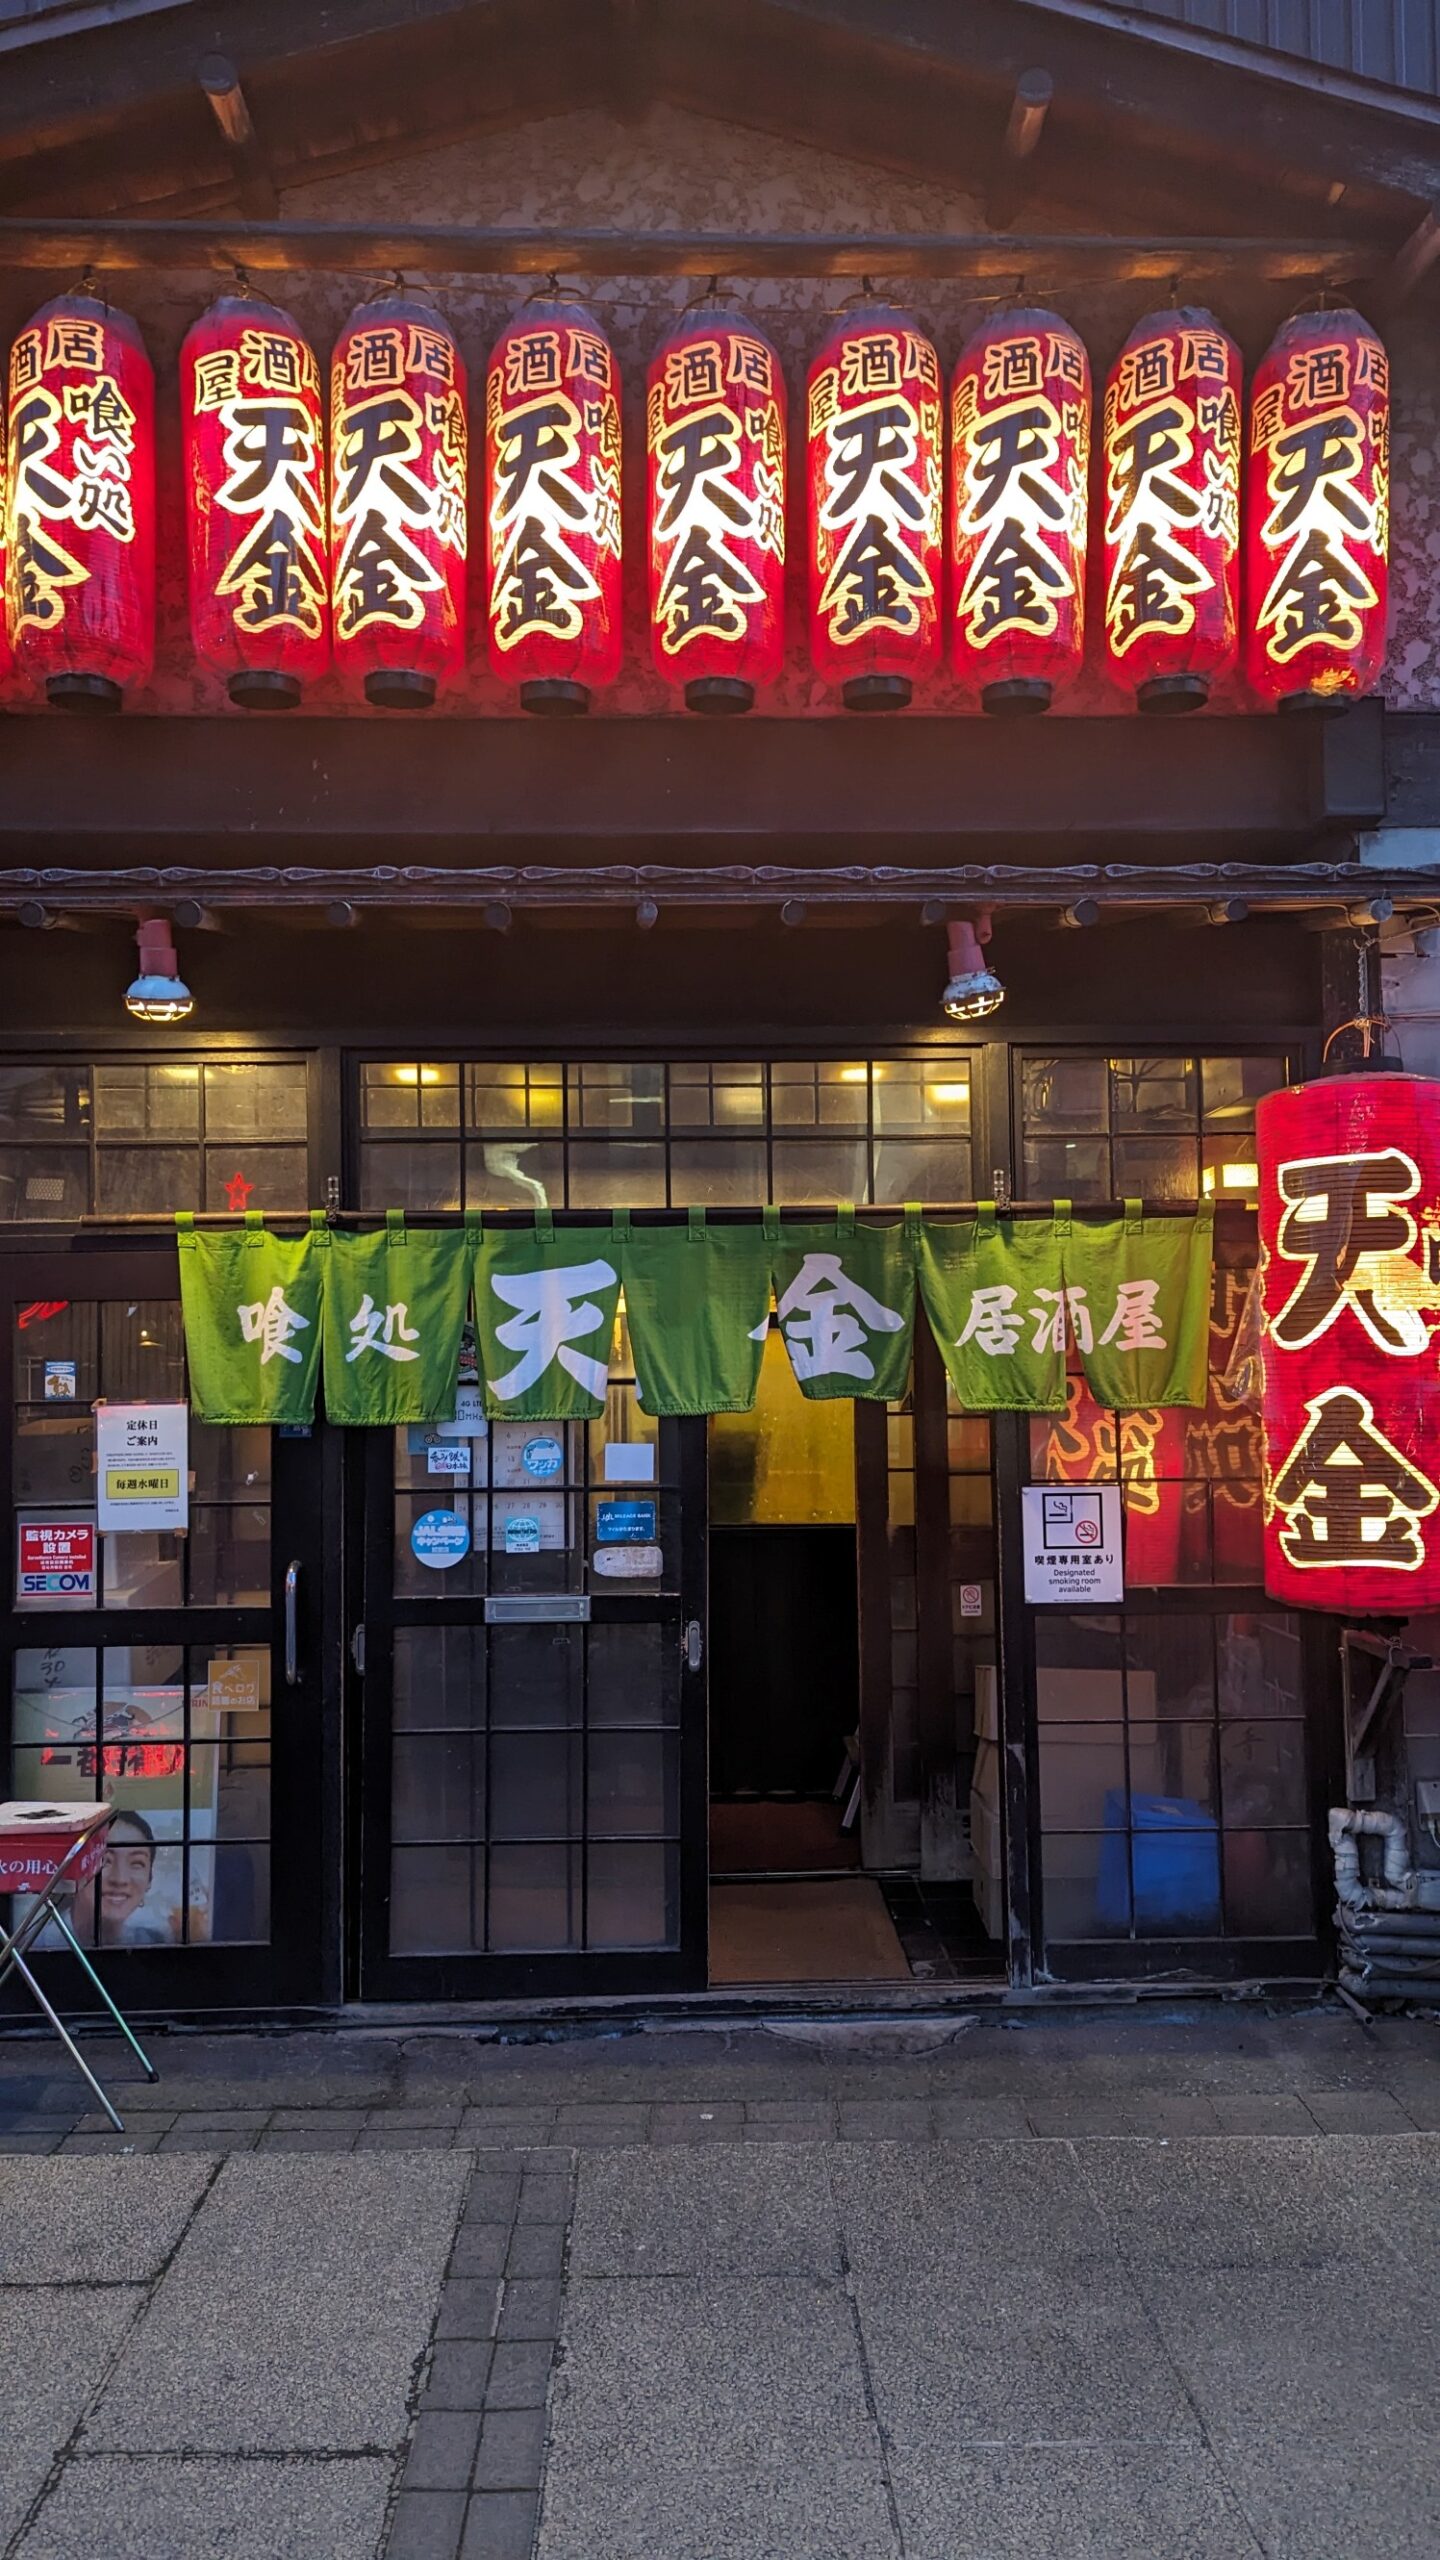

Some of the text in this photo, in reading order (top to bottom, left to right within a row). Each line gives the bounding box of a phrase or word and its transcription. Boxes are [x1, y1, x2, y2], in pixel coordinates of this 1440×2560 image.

[808, 331, 938, 442] 居酒屋
[954, 333, 1085, 442] 居酒屋
[1251, 337, 1388, 457] 居酒屋
[63, 375, 136, 542] 喰い処
[213, 396, 328, 639] 天金
[332, 389, 446, 640] 天金
[1197, 386, 1241, 561] 喰い処
[490, 391, 602, 651] 天金
[653, 402, 768, 655] 天金
[817, 393, 934, 645] 天金
[957, 394, 1075, 649] 天金
[1105, 395, 1217, 658] 天金
[1256, 405, 1379, 664] 天金
[237, 1253, 1167, 1401] 喰処 天金 居酒屋
[1268, 1148, 1440, 1572] 天金
[116, 1479, 169, 1490] 毎週水曜日
[126, 1420, 158, 1431] 定休日
[126, 1435, 158, 1446] ご案内
[24, 1574, 89, 1591] SECOM
[25, 1529, 89, 1541] 監視カメラ
[43, 1542, 71, 1553] 設置
[1034, 1555, 1114, 1566] 喫煙専用室あり
[1048, 1577, 1080, 1586] smoking
[1053, 1569, 1096, 1578] Designated
[1058, 1585, 1092, 1593] available
